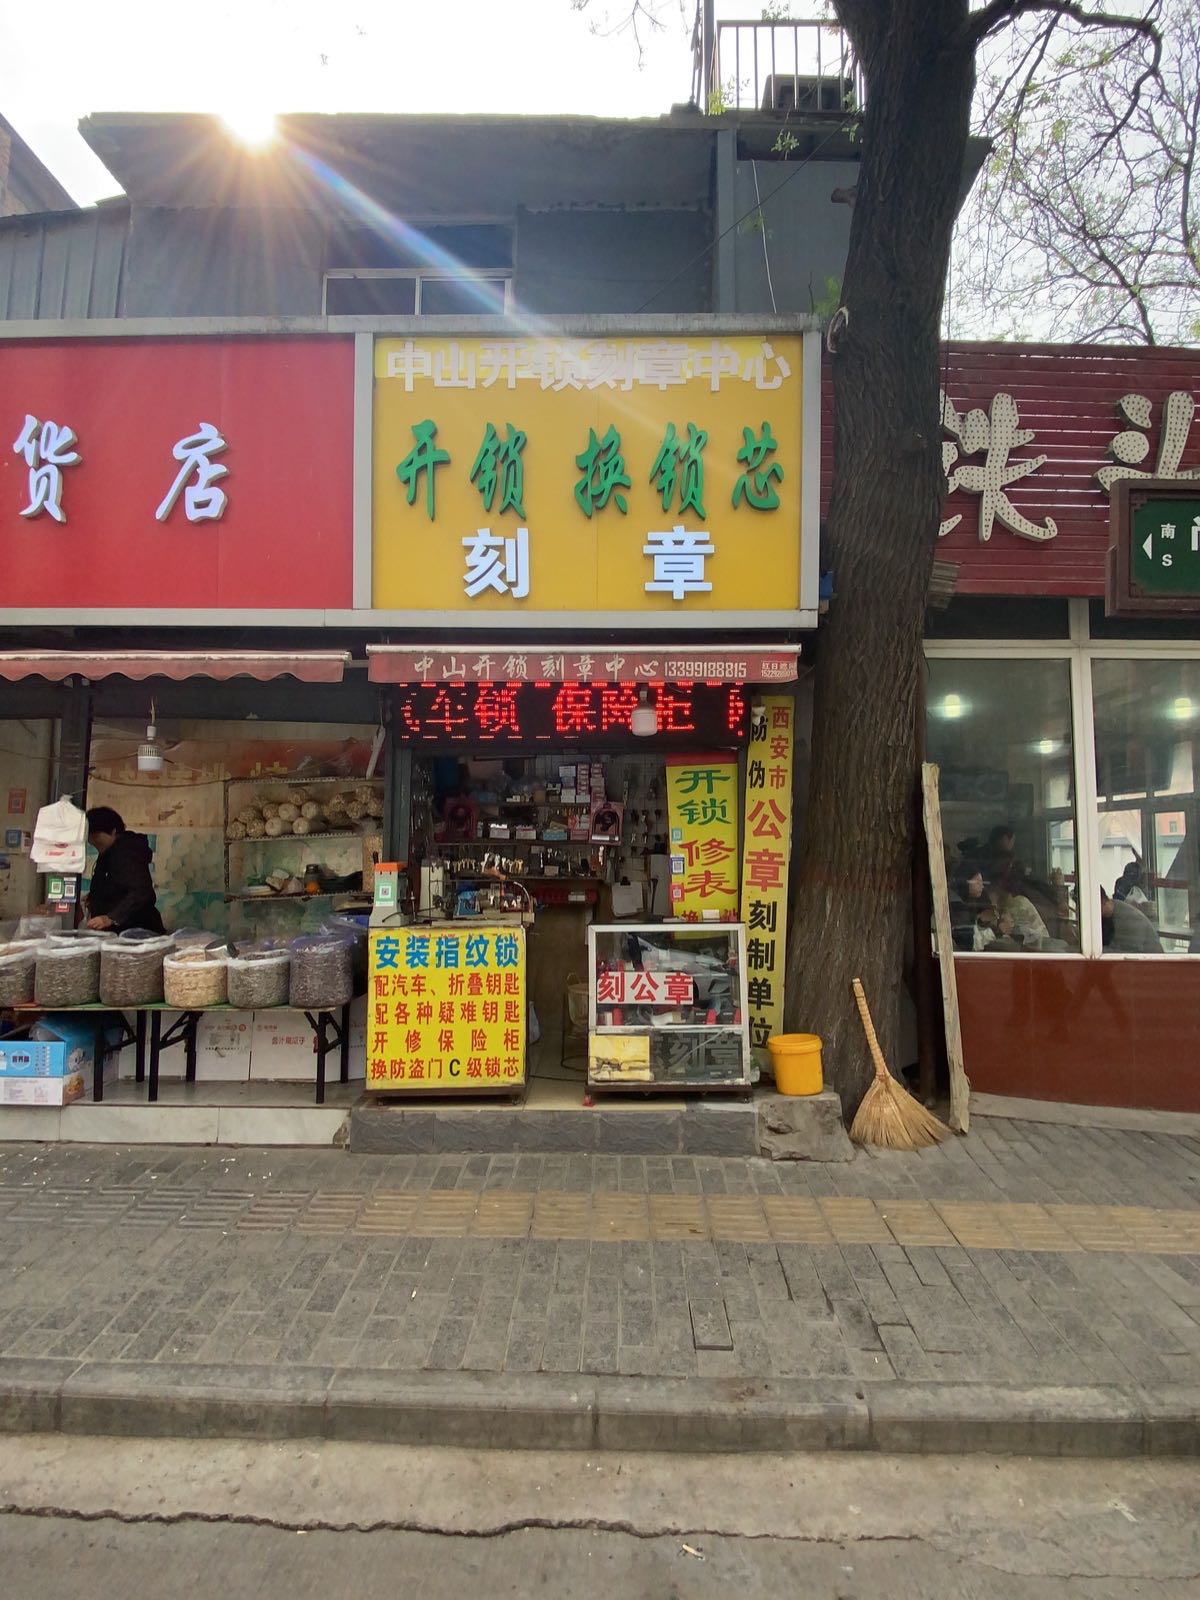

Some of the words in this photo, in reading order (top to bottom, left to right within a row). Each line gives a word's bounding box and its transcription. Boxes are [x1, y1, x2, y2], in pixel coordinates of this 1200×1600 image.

[387, 339, 792, 392] 中山开锁刻章中心
[1161, 523, 1176, 539] 南
[462, 525, 715, 601] 刻章
[1162, 554, 1173, 567] S
[414, 655, 658, 681] 中山开锁刻章中心
[664, 661, 747, 678] 13399188815
[769, 706, 792, 789] 西安市
[376, 935, 519, 969] 安装指纹锁
[597, 970, 693, 1005] 刻公章
[375, 1000, 520, 1026] 配各种疑难钥匙
[373, 1028, 520, 1053] 开修保险柜
